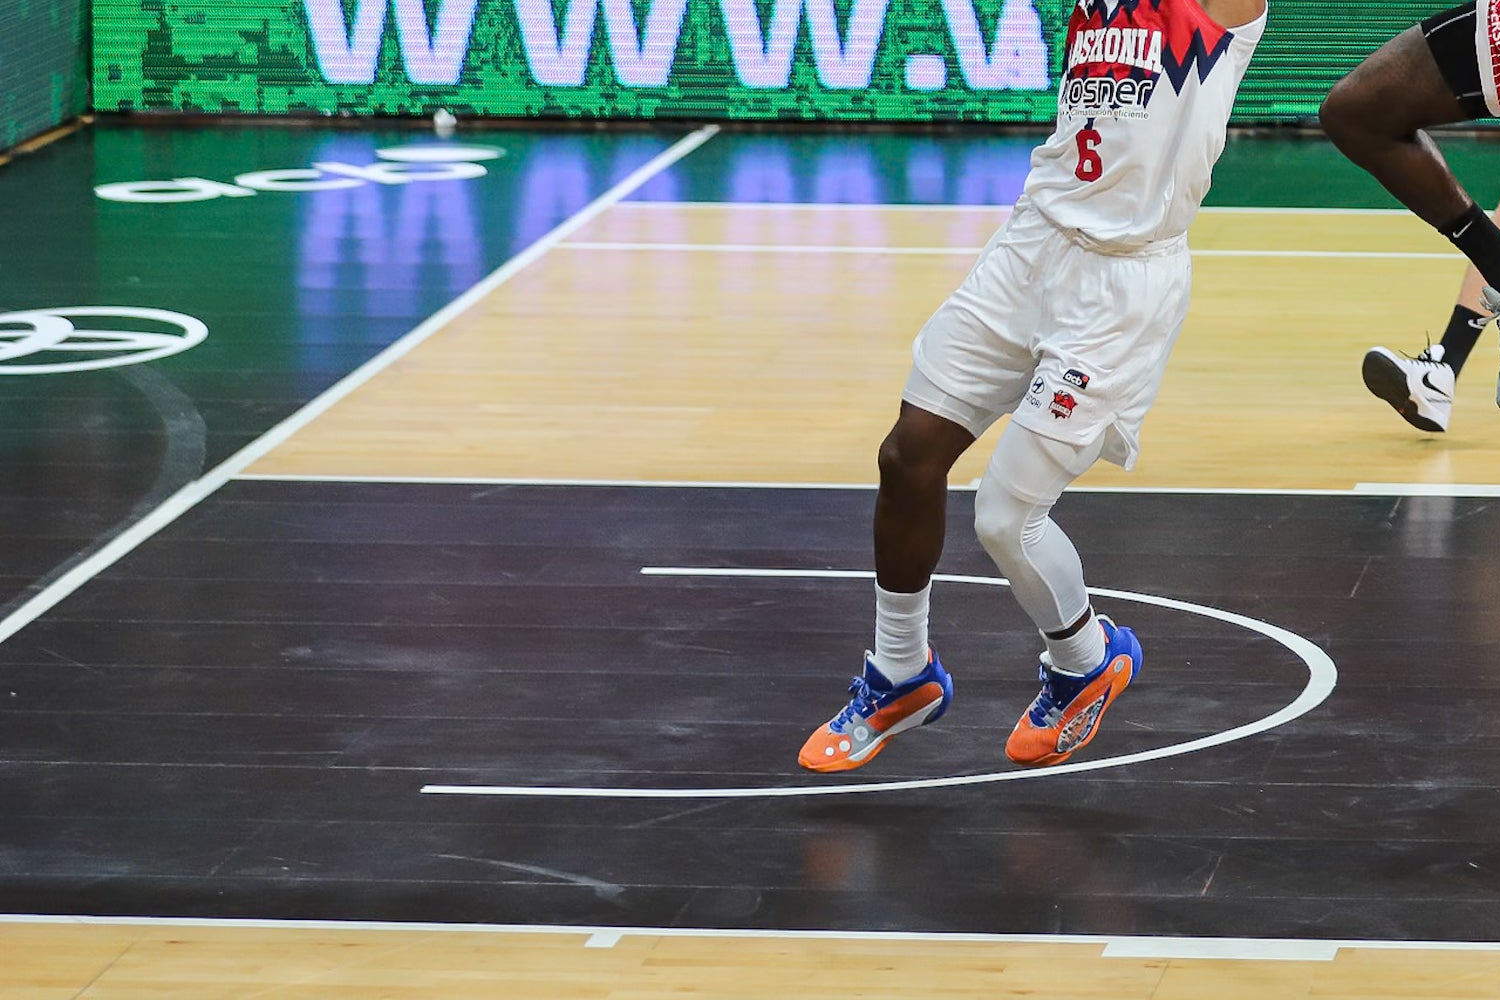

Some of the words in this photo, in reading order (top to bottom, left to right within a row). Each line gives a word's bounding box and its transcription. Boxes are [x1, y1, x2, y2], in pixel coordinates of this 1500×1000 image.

[1068, 26, 1163, 75] ASKONIA
[1075, 129, 1103, 182] 6
[1064, 373, 1083, 386] acb
